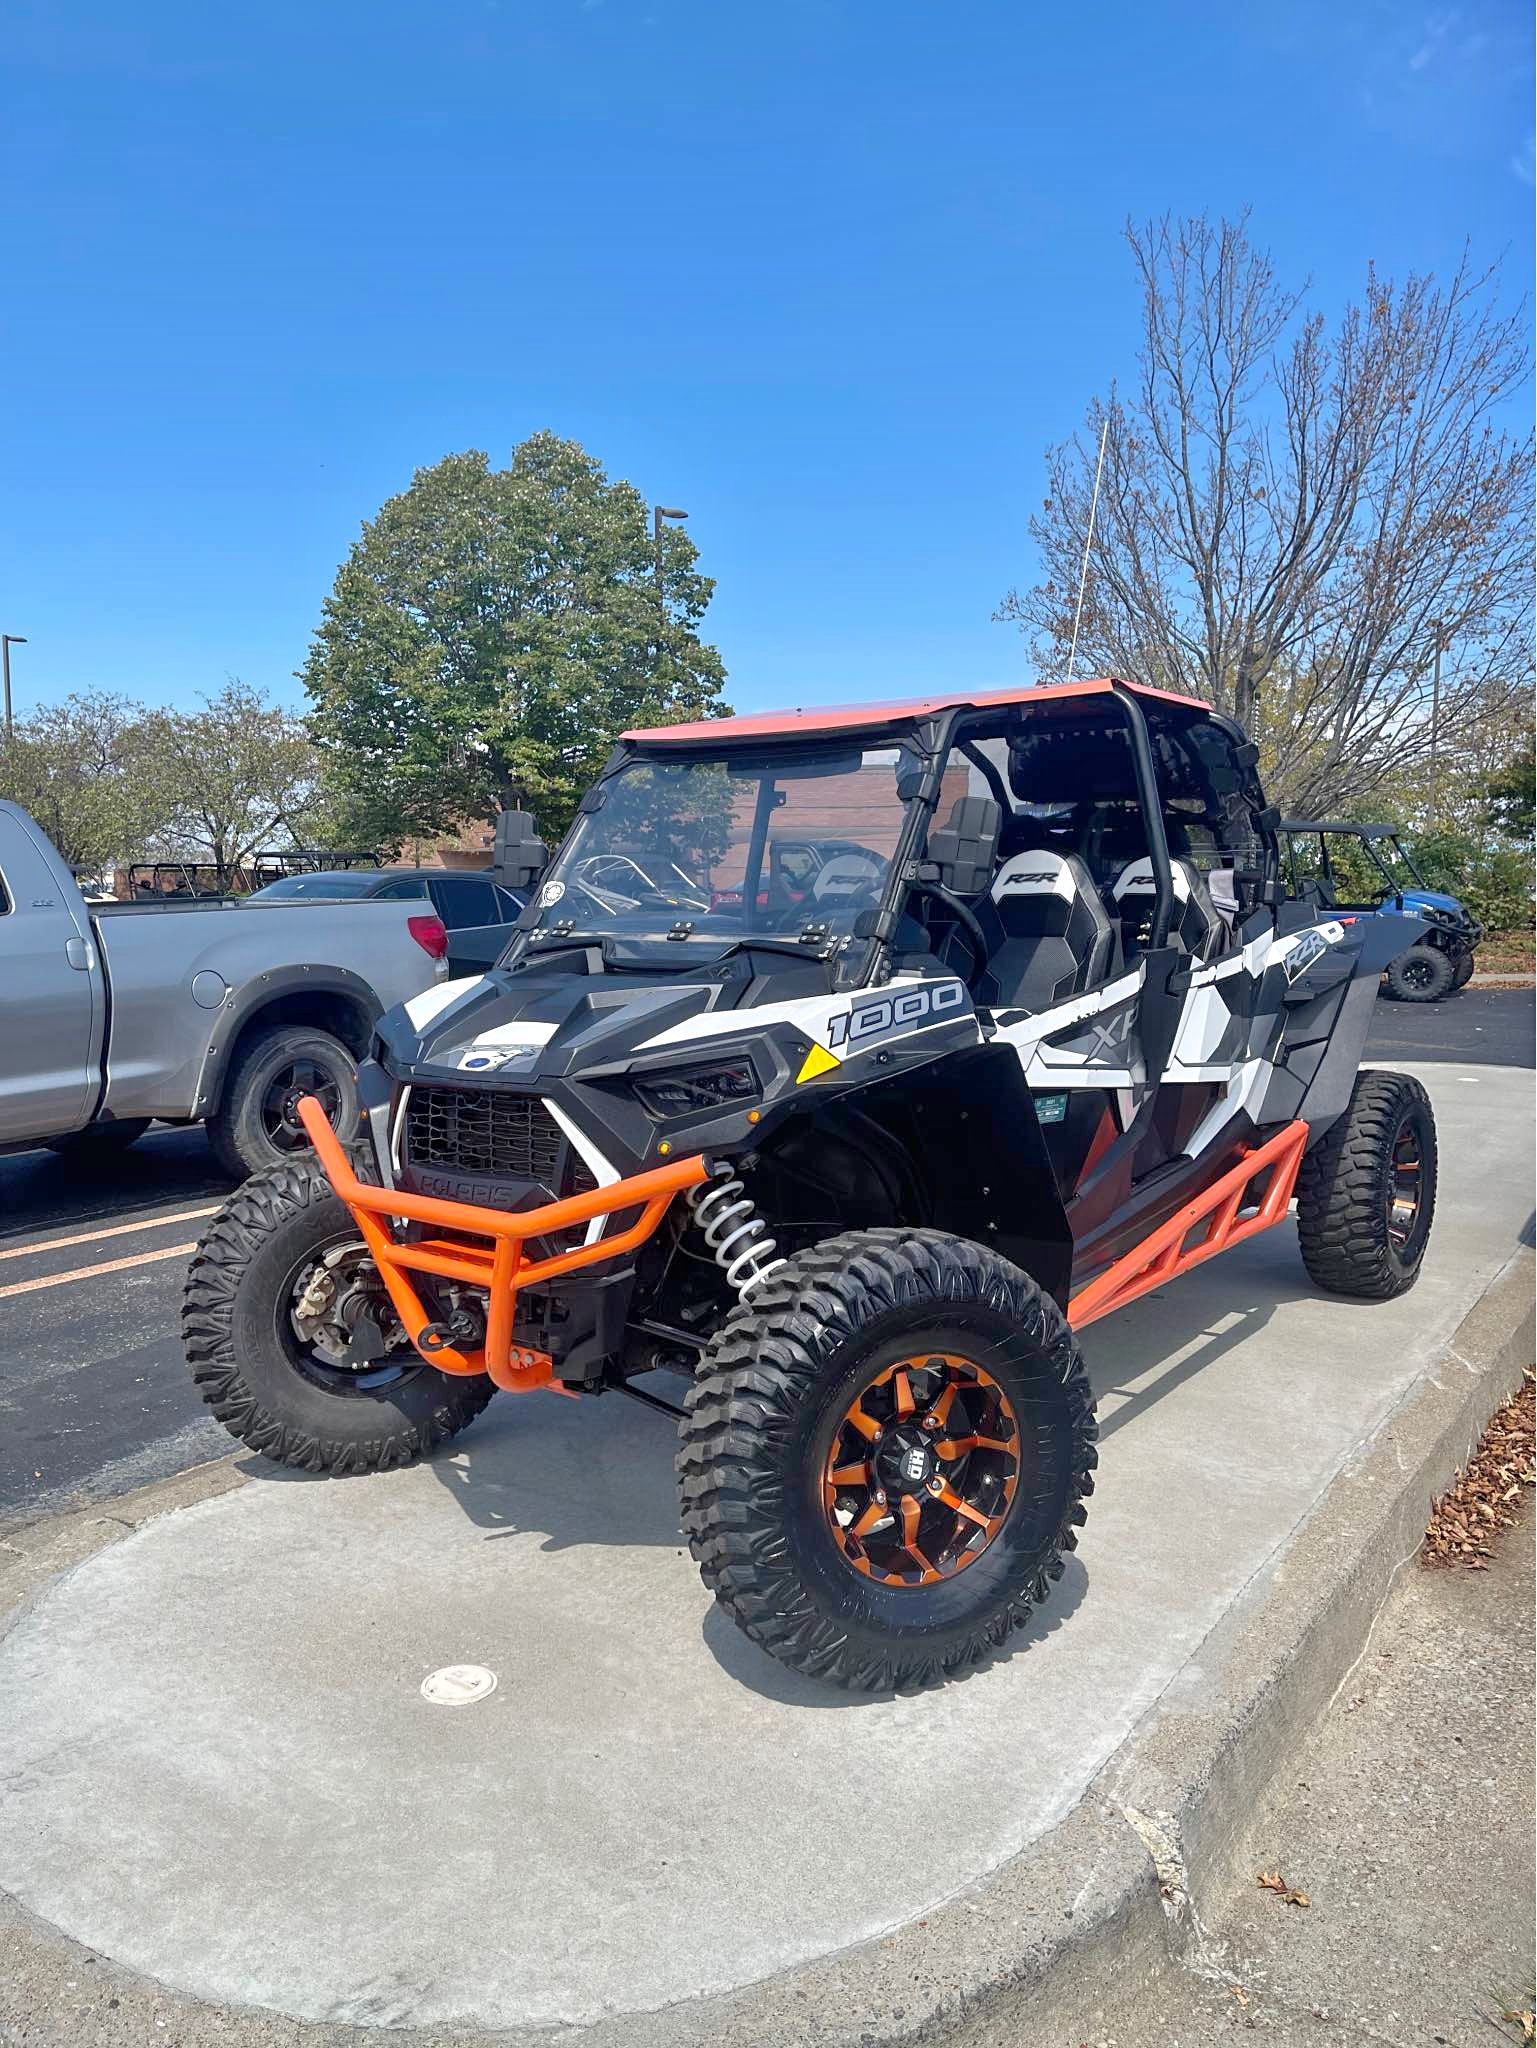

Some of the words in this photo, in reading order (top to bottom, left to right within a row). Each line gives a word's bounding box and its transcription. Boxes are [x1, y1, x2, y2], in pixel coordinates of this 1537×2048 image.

[1003, 872, 1060, 886] RZR
[1285, 931, 1327, 975] RZR
[827, 981, 964, 1049] 1000
[910, 1450, 925, 1480] HD
